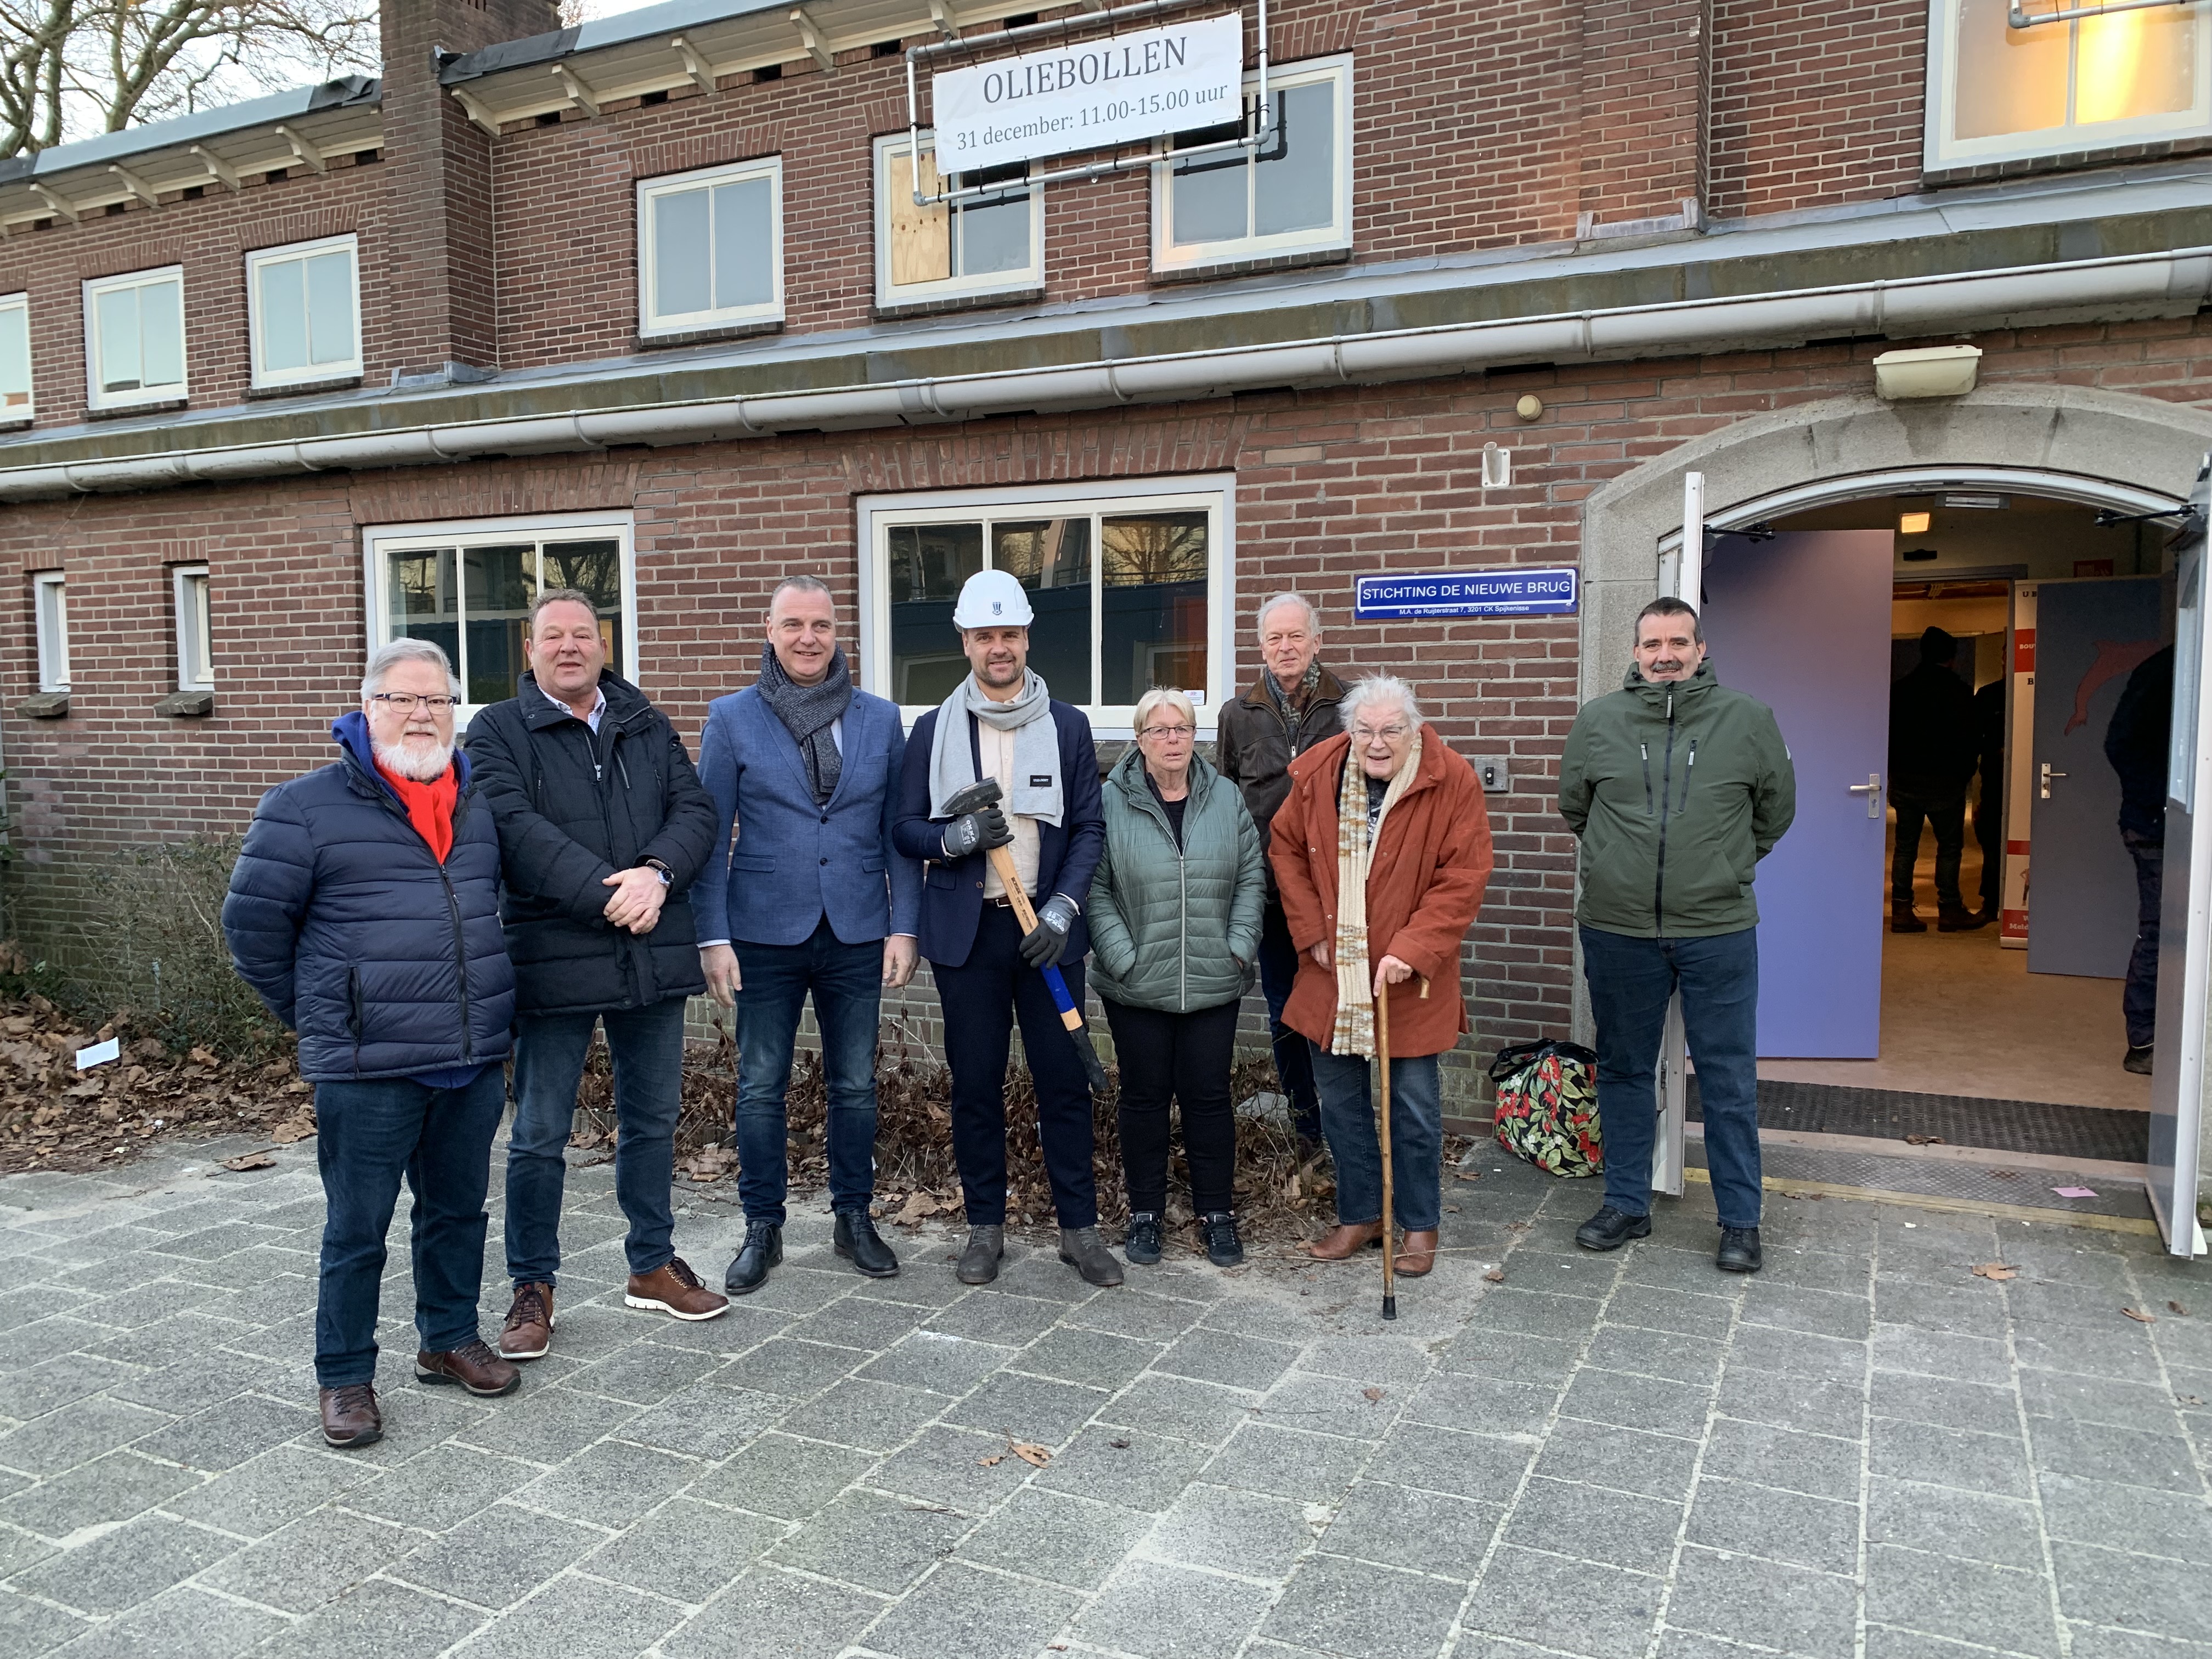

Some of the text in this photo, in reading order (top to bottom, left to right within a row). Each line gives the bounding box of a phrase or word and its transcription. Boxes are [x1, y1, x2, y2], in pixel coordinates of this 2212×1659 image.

[983, 36, 1188, 104] OLIEBOLLEN
[957, 84, 1228, 150] 31 december: 11.00-15.00 uur
[1363, 581, 1571, 600] STICHTING DE NIEUWE BRUG
[1494, 605, 1530, 613] Spijkenisse
